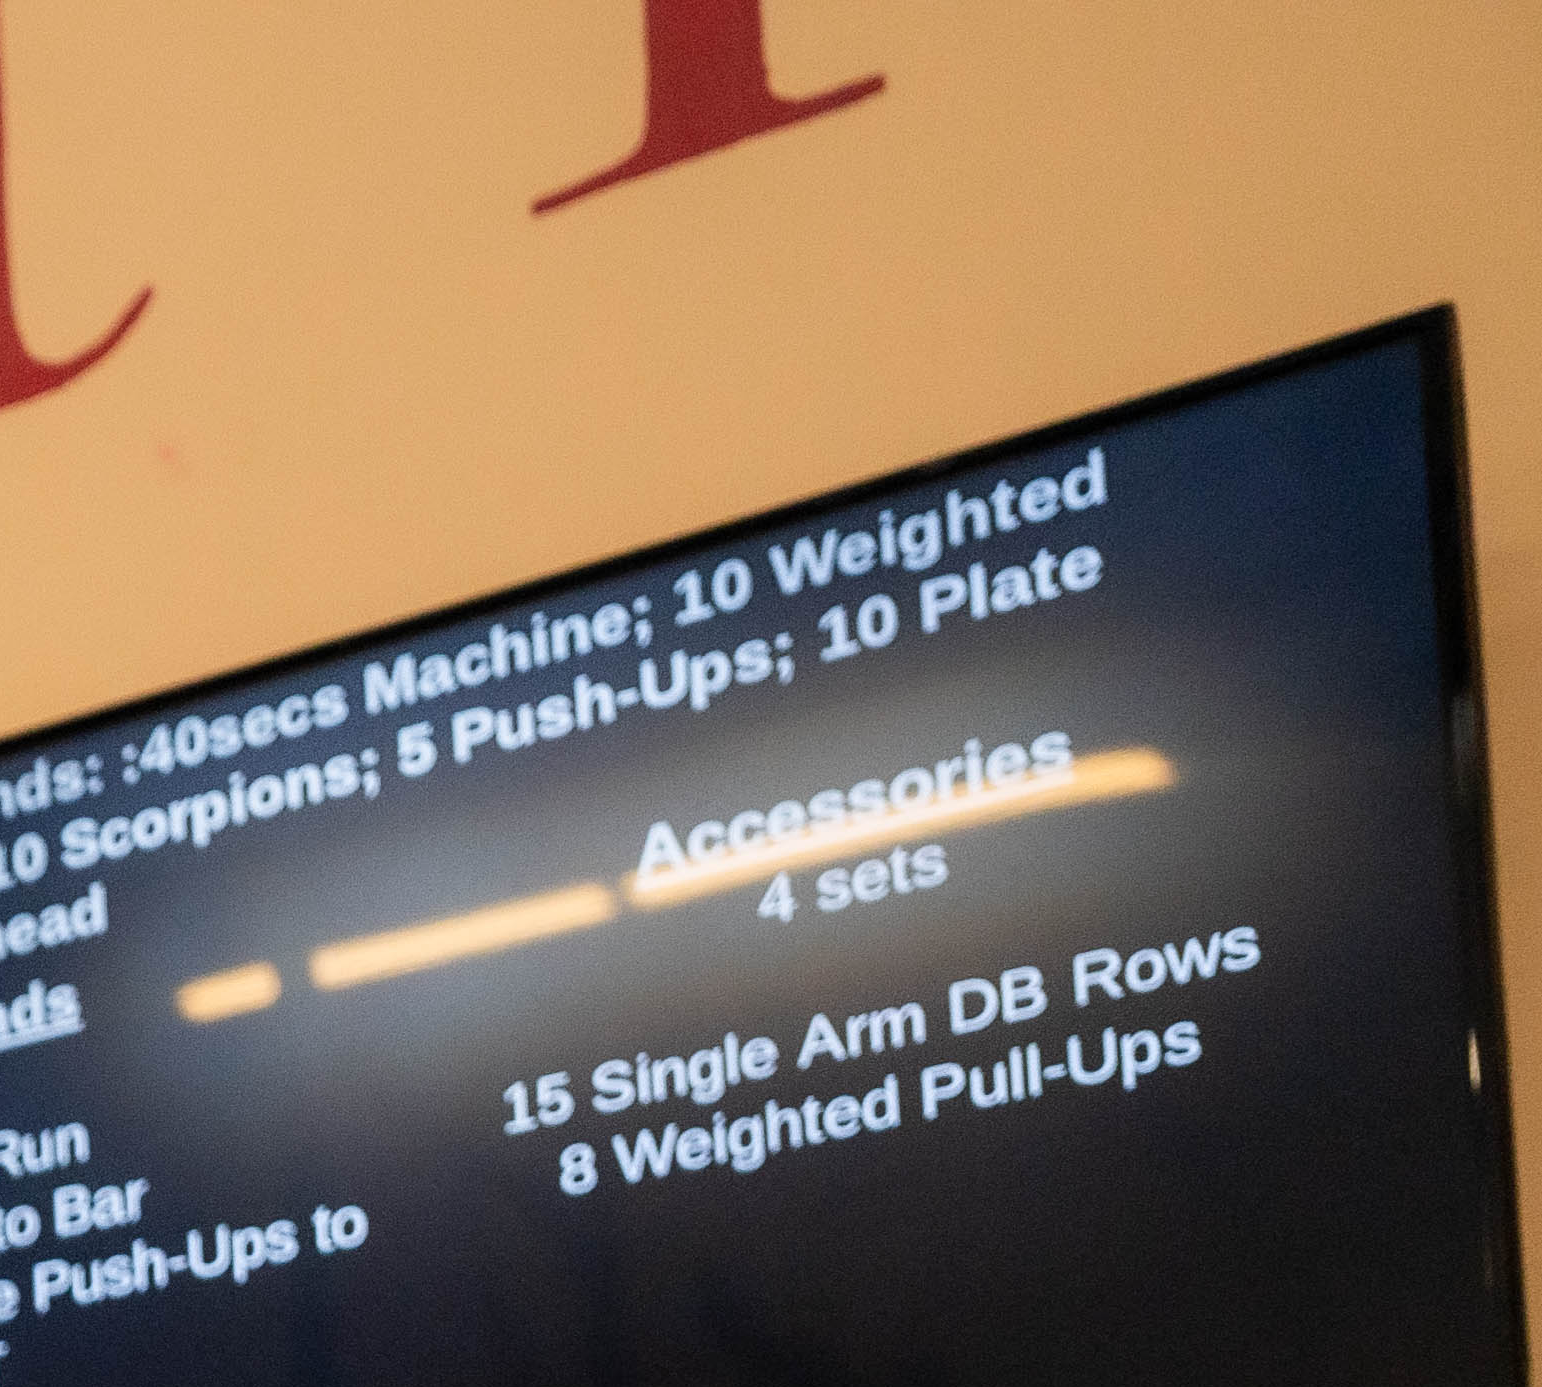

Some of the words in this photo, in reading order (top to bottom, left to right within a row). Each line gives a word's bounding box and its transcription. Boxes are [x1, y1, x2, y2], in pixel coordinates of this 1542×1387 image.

[121, 683, 349, 785] :40secs
[362, 594, 652, 713] Machine;
[673, 557, 753, 627] 10
[769, 446, 1108, 596] Weighted
[60, 748, 381, 870] Scorpions;
[397, 720, 438, 778] 5
[451, 631, 795, 765] Push-Ups;
[818, 593, 899, 662] 10
[919, 544, 1105, 634] Plate
[636, 729, 1074, 886] Accessories
[756, 870, 797, 923] 4
[815, 844, 949, 914] sets
[502, 1071, 575, 1135] 15
[591, 1031, 780, 1113] Single
[796, 1001, 927, 1069] Arm
[948, 966, 1049, 1036] DB
[1073, 925, 1262, 1008] Rows
[559, 1142, 599, 1197] 8
[611, 1073, 902, 1185] Weighted
[920, 1020, 1203, 1122] Pull-Ups
[32, 1217, 300, 1315] Push-Ups
[311, 1204, 370, 1255] to
[52, 1178, 150, 1240] Bar
